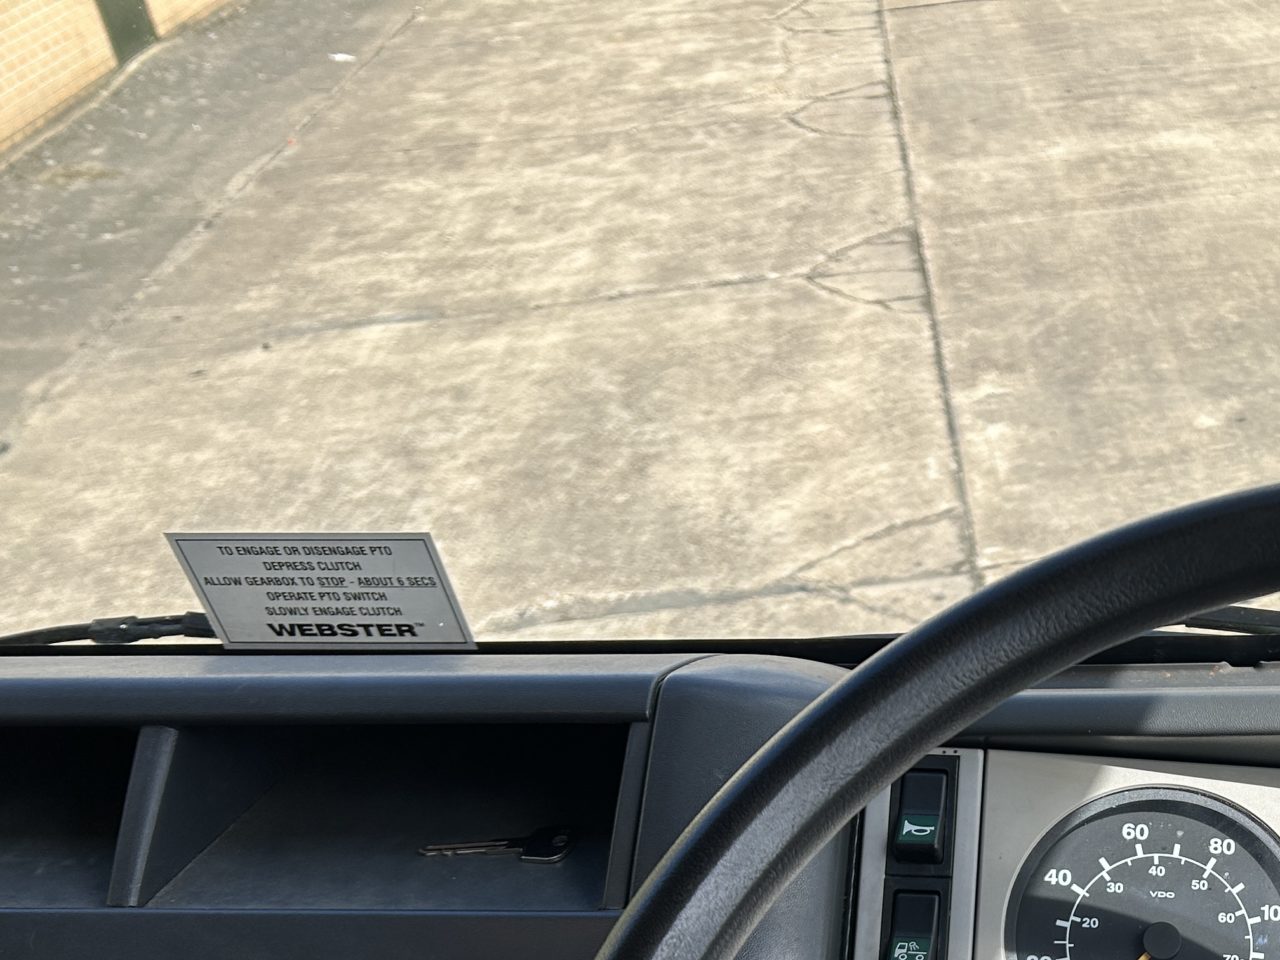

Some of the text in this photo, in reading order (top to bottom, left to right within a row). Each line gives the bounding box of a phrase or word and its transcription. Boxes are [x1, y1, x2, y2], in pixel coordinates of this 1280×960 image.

[216, 546, 393, 555] TO ENGAGE OR DISENGAGE PTO
[263, 561, 362, 571] DEPRESS CLUTCH
[203, 577, 242, 586] ALLOW
[244, 577, 298, 586] GEARBOX
[298, 577, 315, 586] TO
[317, 577, 346, 587] STOP
[358, 577, 394, 587] ABOUT
[397, 577, 405, 586] 6
[406, 577, 437, 587] SECS
[266, 592, 388, 601] OPERATE PTO SWITCH
[265, 607, 403, 616] SLOWLY ENGAGE CLUTCH
[1122, 824, 1149, 841] 60
[1208, 838, 1236, 855] 80
[1148, 866, 1165, 877] 40
[1044, 869, 1073, 886] 40
[1106, 882, 1124, 894] 30
[1191, 880, 1209, 891] 50
[1149, 891, 1175, 899] VDO
[1081, 918, 1099, 929] 20
[1217, 912, 1235, 924] 60
